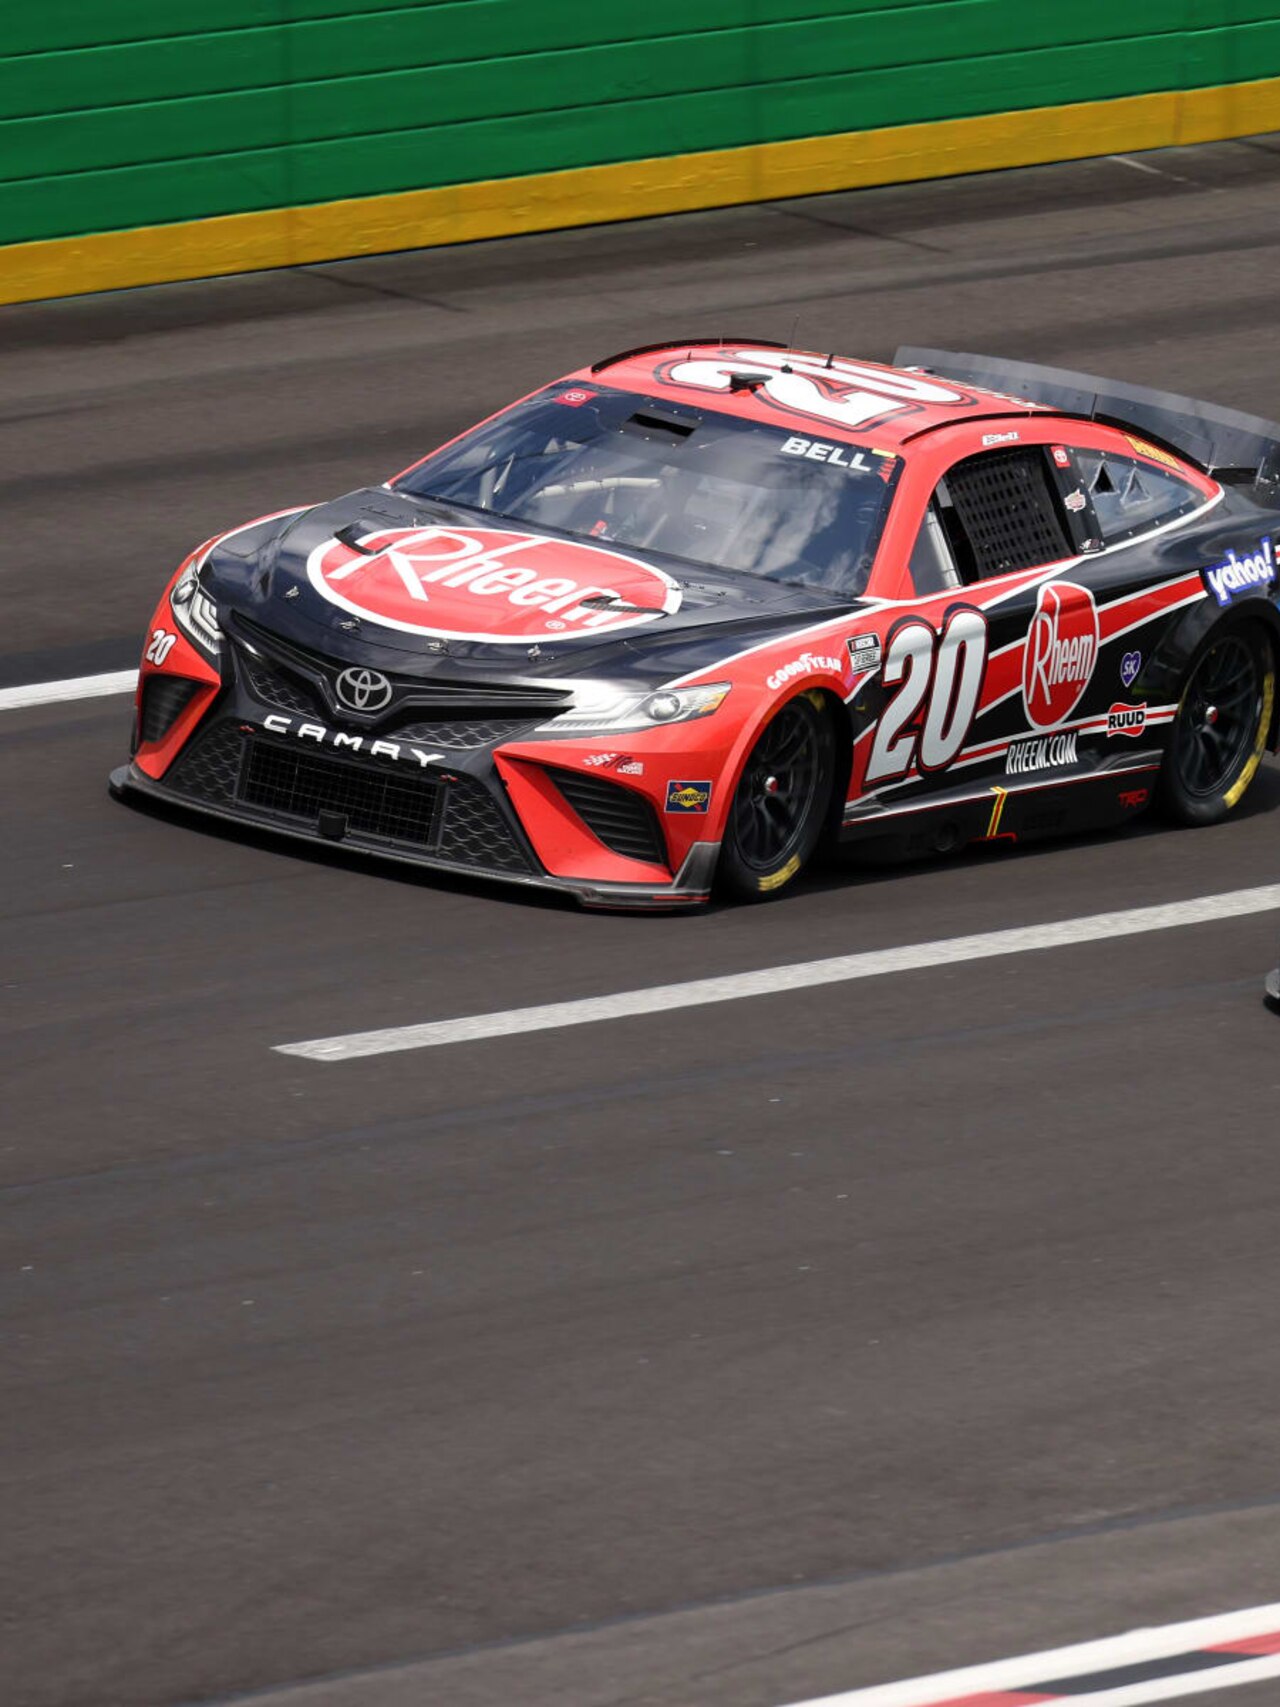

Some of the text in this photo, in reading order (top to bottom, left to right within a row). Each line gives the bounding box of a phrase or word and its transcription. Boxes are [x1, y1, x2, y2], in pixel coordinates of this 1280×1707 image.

[780, 435, 872, 472] BELL
[325, 528, 634, 627] Rheem
[1207, 540, 1275, 602] yahoo!
[146, 629, 177, 667] 20
[1027, 594, 1094, 706] Rheem
[1122, 659, 1137, 675] SK
[766, 652, 842, 690] GOODYEAR
[863, 610, 988, 782] 20
[1107, 710, 1145, 729] RUUD
[263, 714, 446, 768] CAMRY
[1005, 732, 1079, 775] RHEEM.COM
[670, 791, 708, 803] SUNOCO
